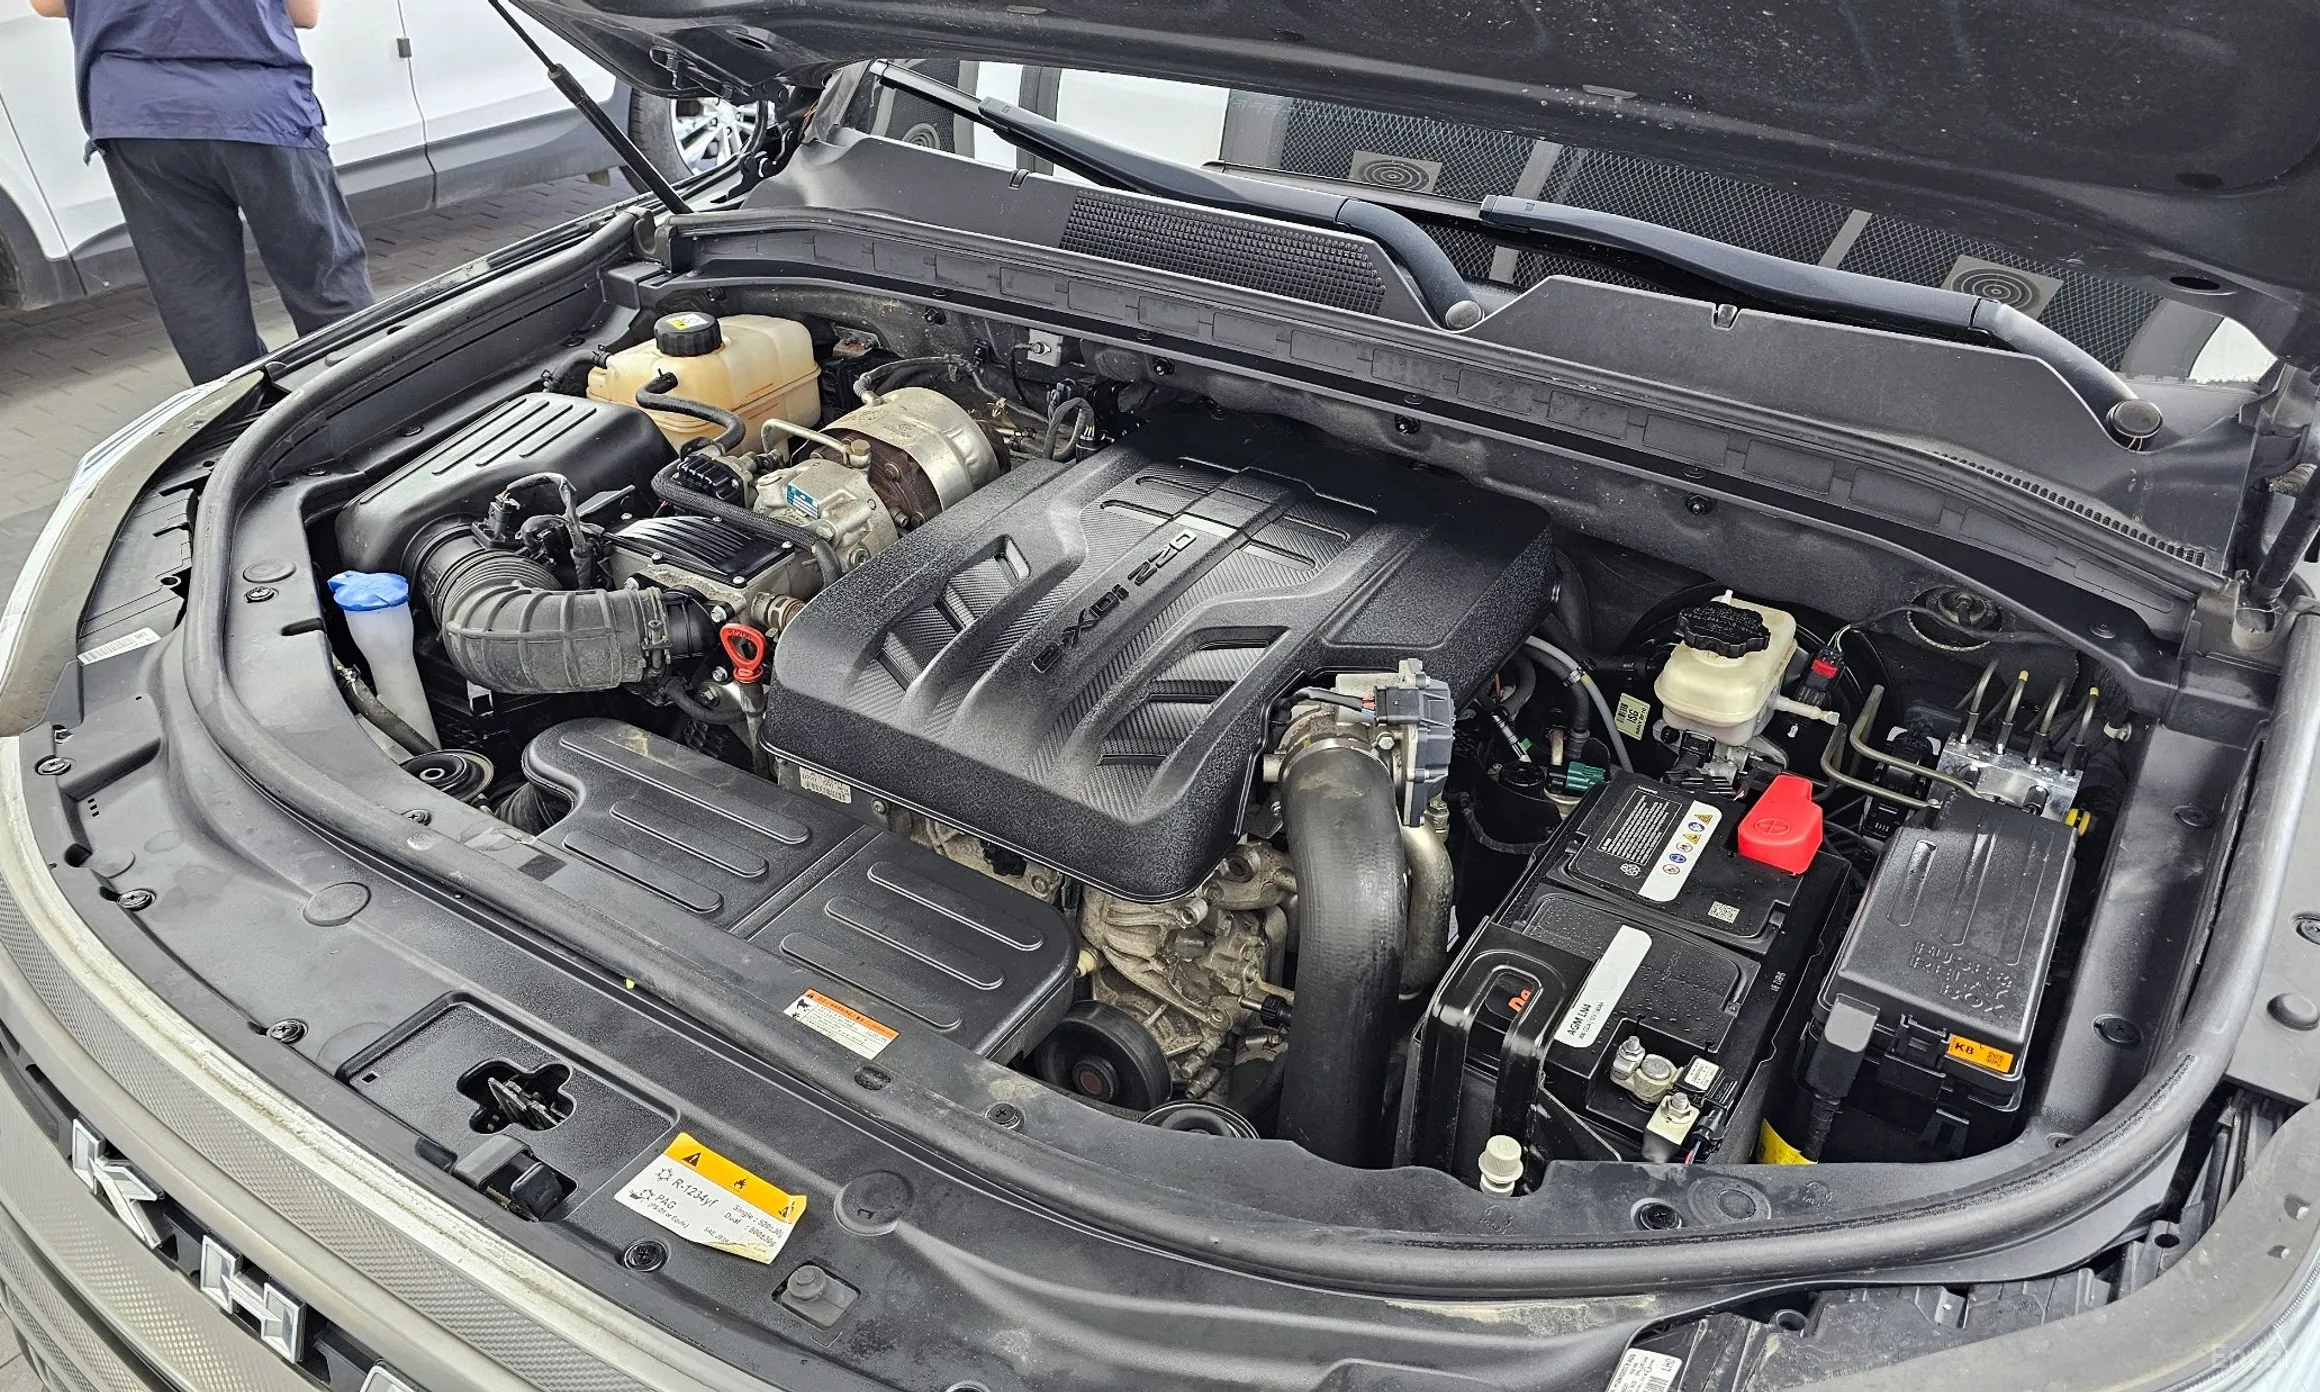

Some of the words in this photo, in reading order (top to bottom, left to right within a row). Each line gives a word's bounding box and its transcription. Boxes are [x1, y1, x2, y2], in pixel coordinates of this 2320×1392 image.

[1127, 528, 1198, 587] 220
[1626, 708, 1639, 725] ISG
[1938, 981, 2005, 1018] BOX
[1566, 1016, 1582, 1037] AGM
[1579, 1002, 1592, 1020] LN4
[655, 1193, 678, 1211] PAG
[671, 1177, 720, 1209] R-1234yf
[724, 1211, 741, 1226] Dual
[732, 1203, 754, 1222] Single
[703, 1225, 716, 1239] SAE
